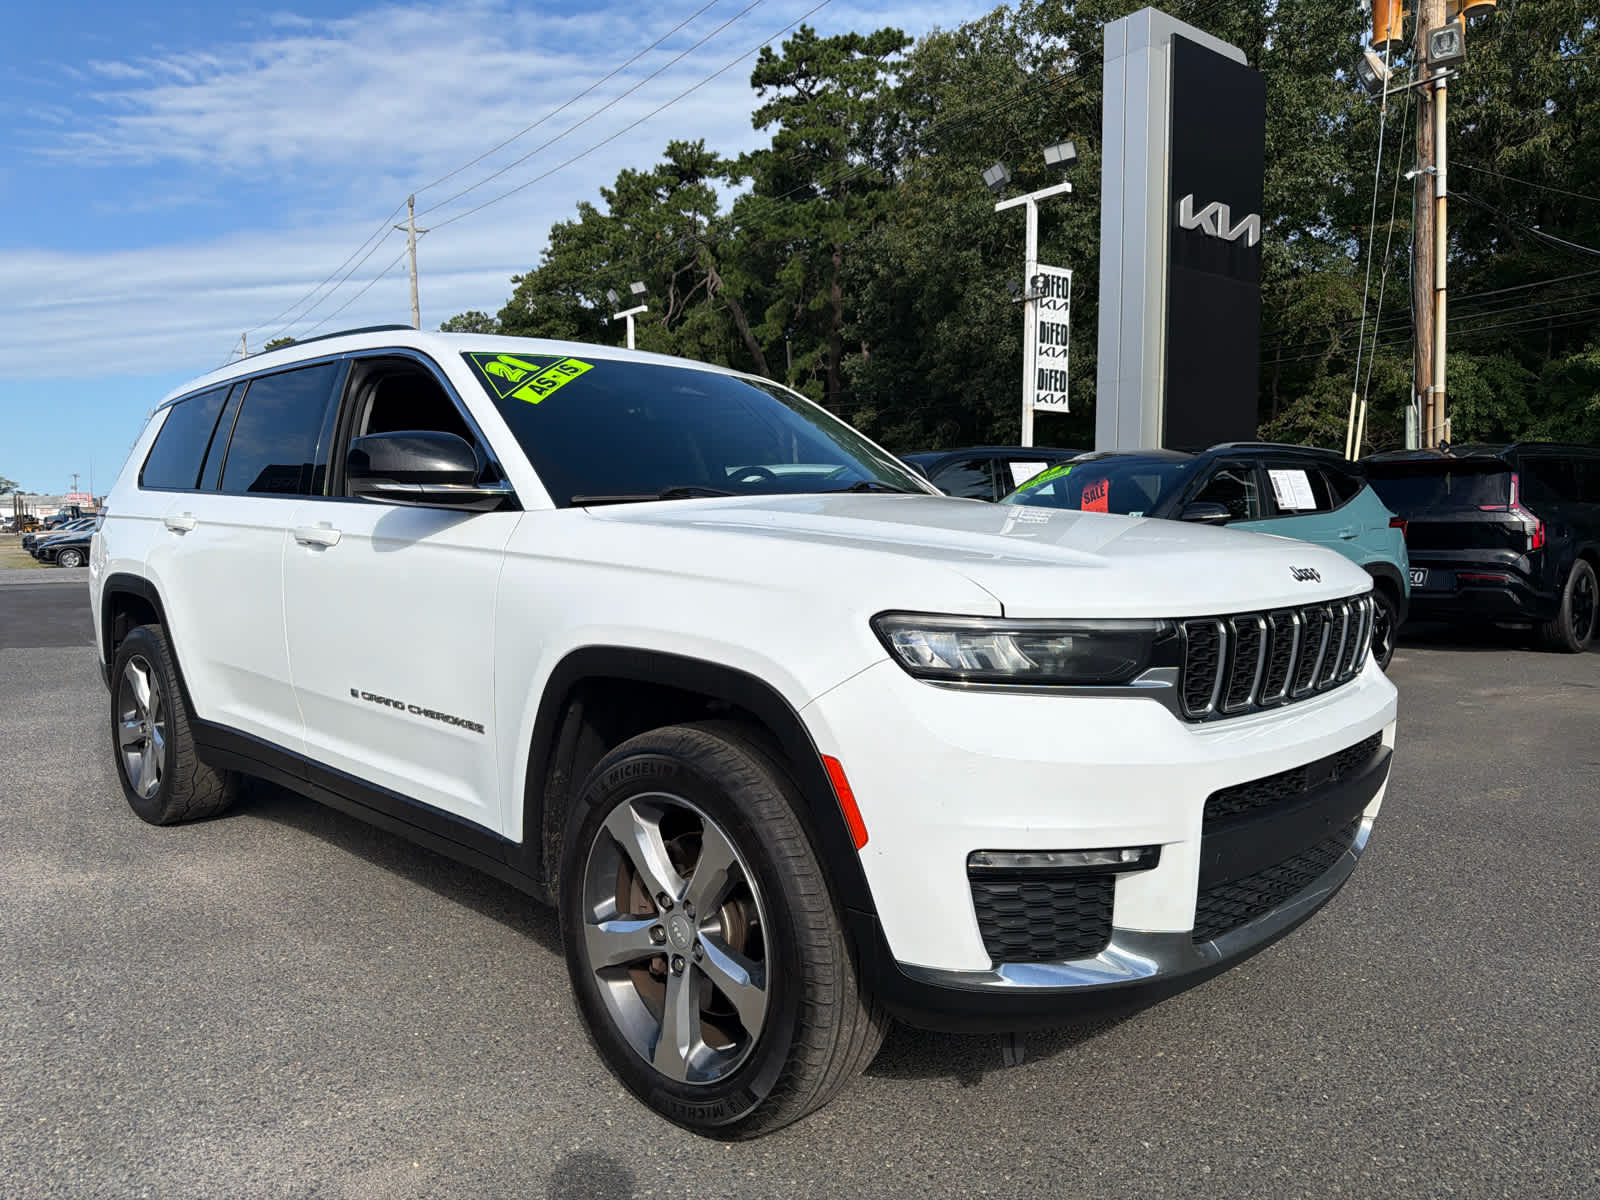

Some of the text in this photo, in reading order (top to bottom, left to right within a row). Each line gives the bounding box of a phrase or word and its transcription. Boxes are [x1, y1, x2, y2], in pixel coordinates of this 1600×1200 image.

[1179, 193, 1261, 247] KIA
[1039, 346, 1068, 358] KIA
[485, 355, 541, 382] 21
[1036, 393, 1066, 405] KIA
[1083, 484, 1106, 504] SALE
[1289, 566, 1321, 583] Jeep
[361, 691, 485, 734] GRAND CHEROKEE
